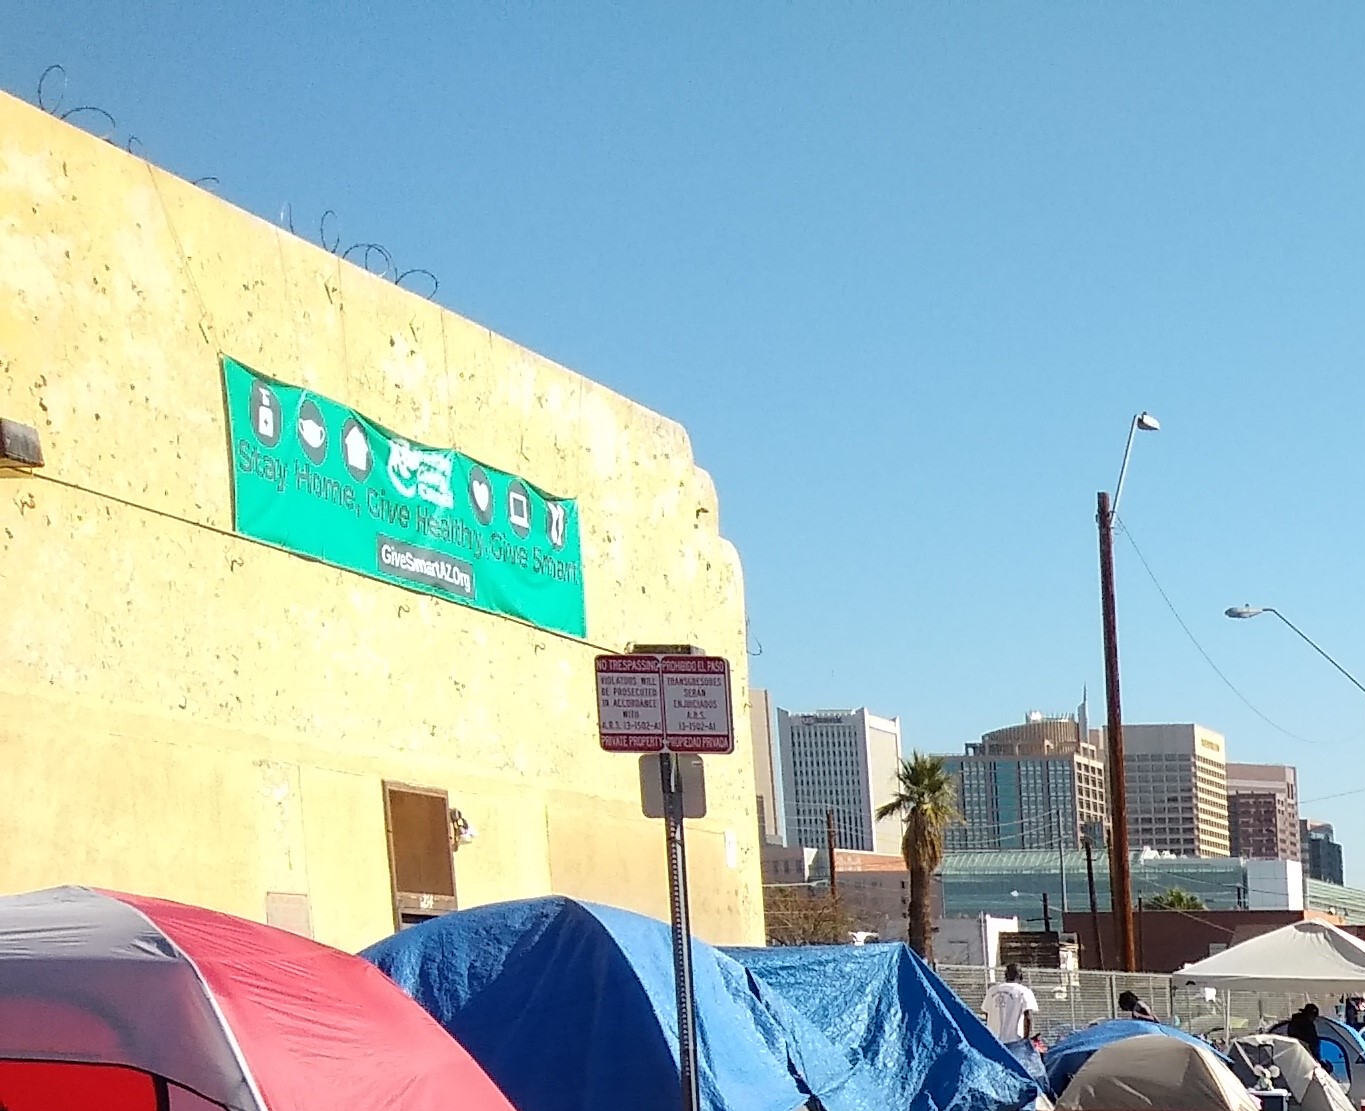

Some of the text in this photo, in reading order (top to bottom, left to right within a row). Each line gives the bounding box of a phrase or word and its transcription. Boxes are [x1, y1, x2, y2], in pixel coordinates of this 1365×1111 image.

[238, 439, 287, 493] Stay
[295, 458, 361, 518] Home,
[367, 488, 410, 528] Give
[491, 531, 528, 569] Give
[596, 659, 658, 671] NO TRESPASSING
[662, 660, 696, 672] PROHIBIDO
[707, 660, 724, 672] PASO
[601, 676, 657, 686] VIOLATORS WILL
[601, 687, 657, 696] BE PROSECUTED
[602, 699, 657, 708] IN ACCORDANCE
[622, 710, 640, 719] WITH
[601, 736, 663, 747] PRIVATE PROPERTY
[703, 737, 729, 748] PRIVADA
